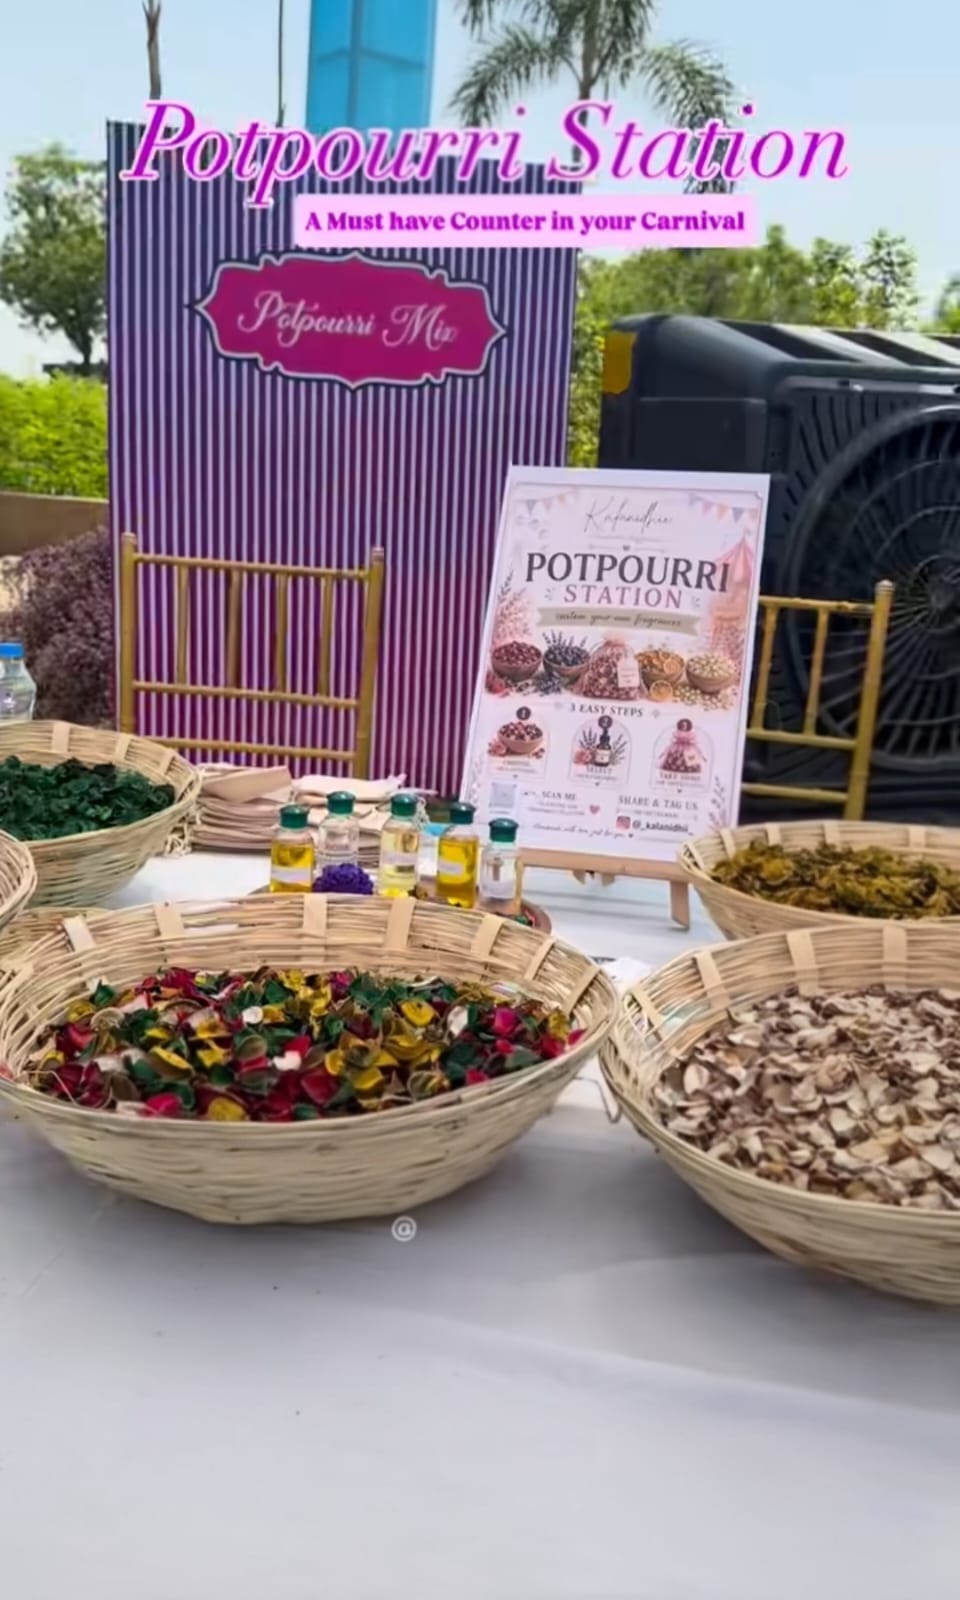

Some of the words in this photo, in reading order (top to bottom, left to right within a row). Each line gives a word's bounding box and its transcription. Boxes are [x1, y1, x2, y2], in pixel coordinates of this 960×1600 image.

[236, 287, 376, 351] Potpourri
[381, 301, 460, 351] Mix
[525, 551, 731, 593] POTPOURRI
[563, 583, 683, 610] STATION
[569, 702, 577, 713] 3
[579, 703, 607, 716] EASY
[609, 706, 644, 718] STEPS
[541, 790, 563, 800] SCAN
[564, 792, 577, 801] ME
[618, 795, 651, 808] SHARE
[663, 799, 682, 810] TAG
[685, 801, 699, 811] US
